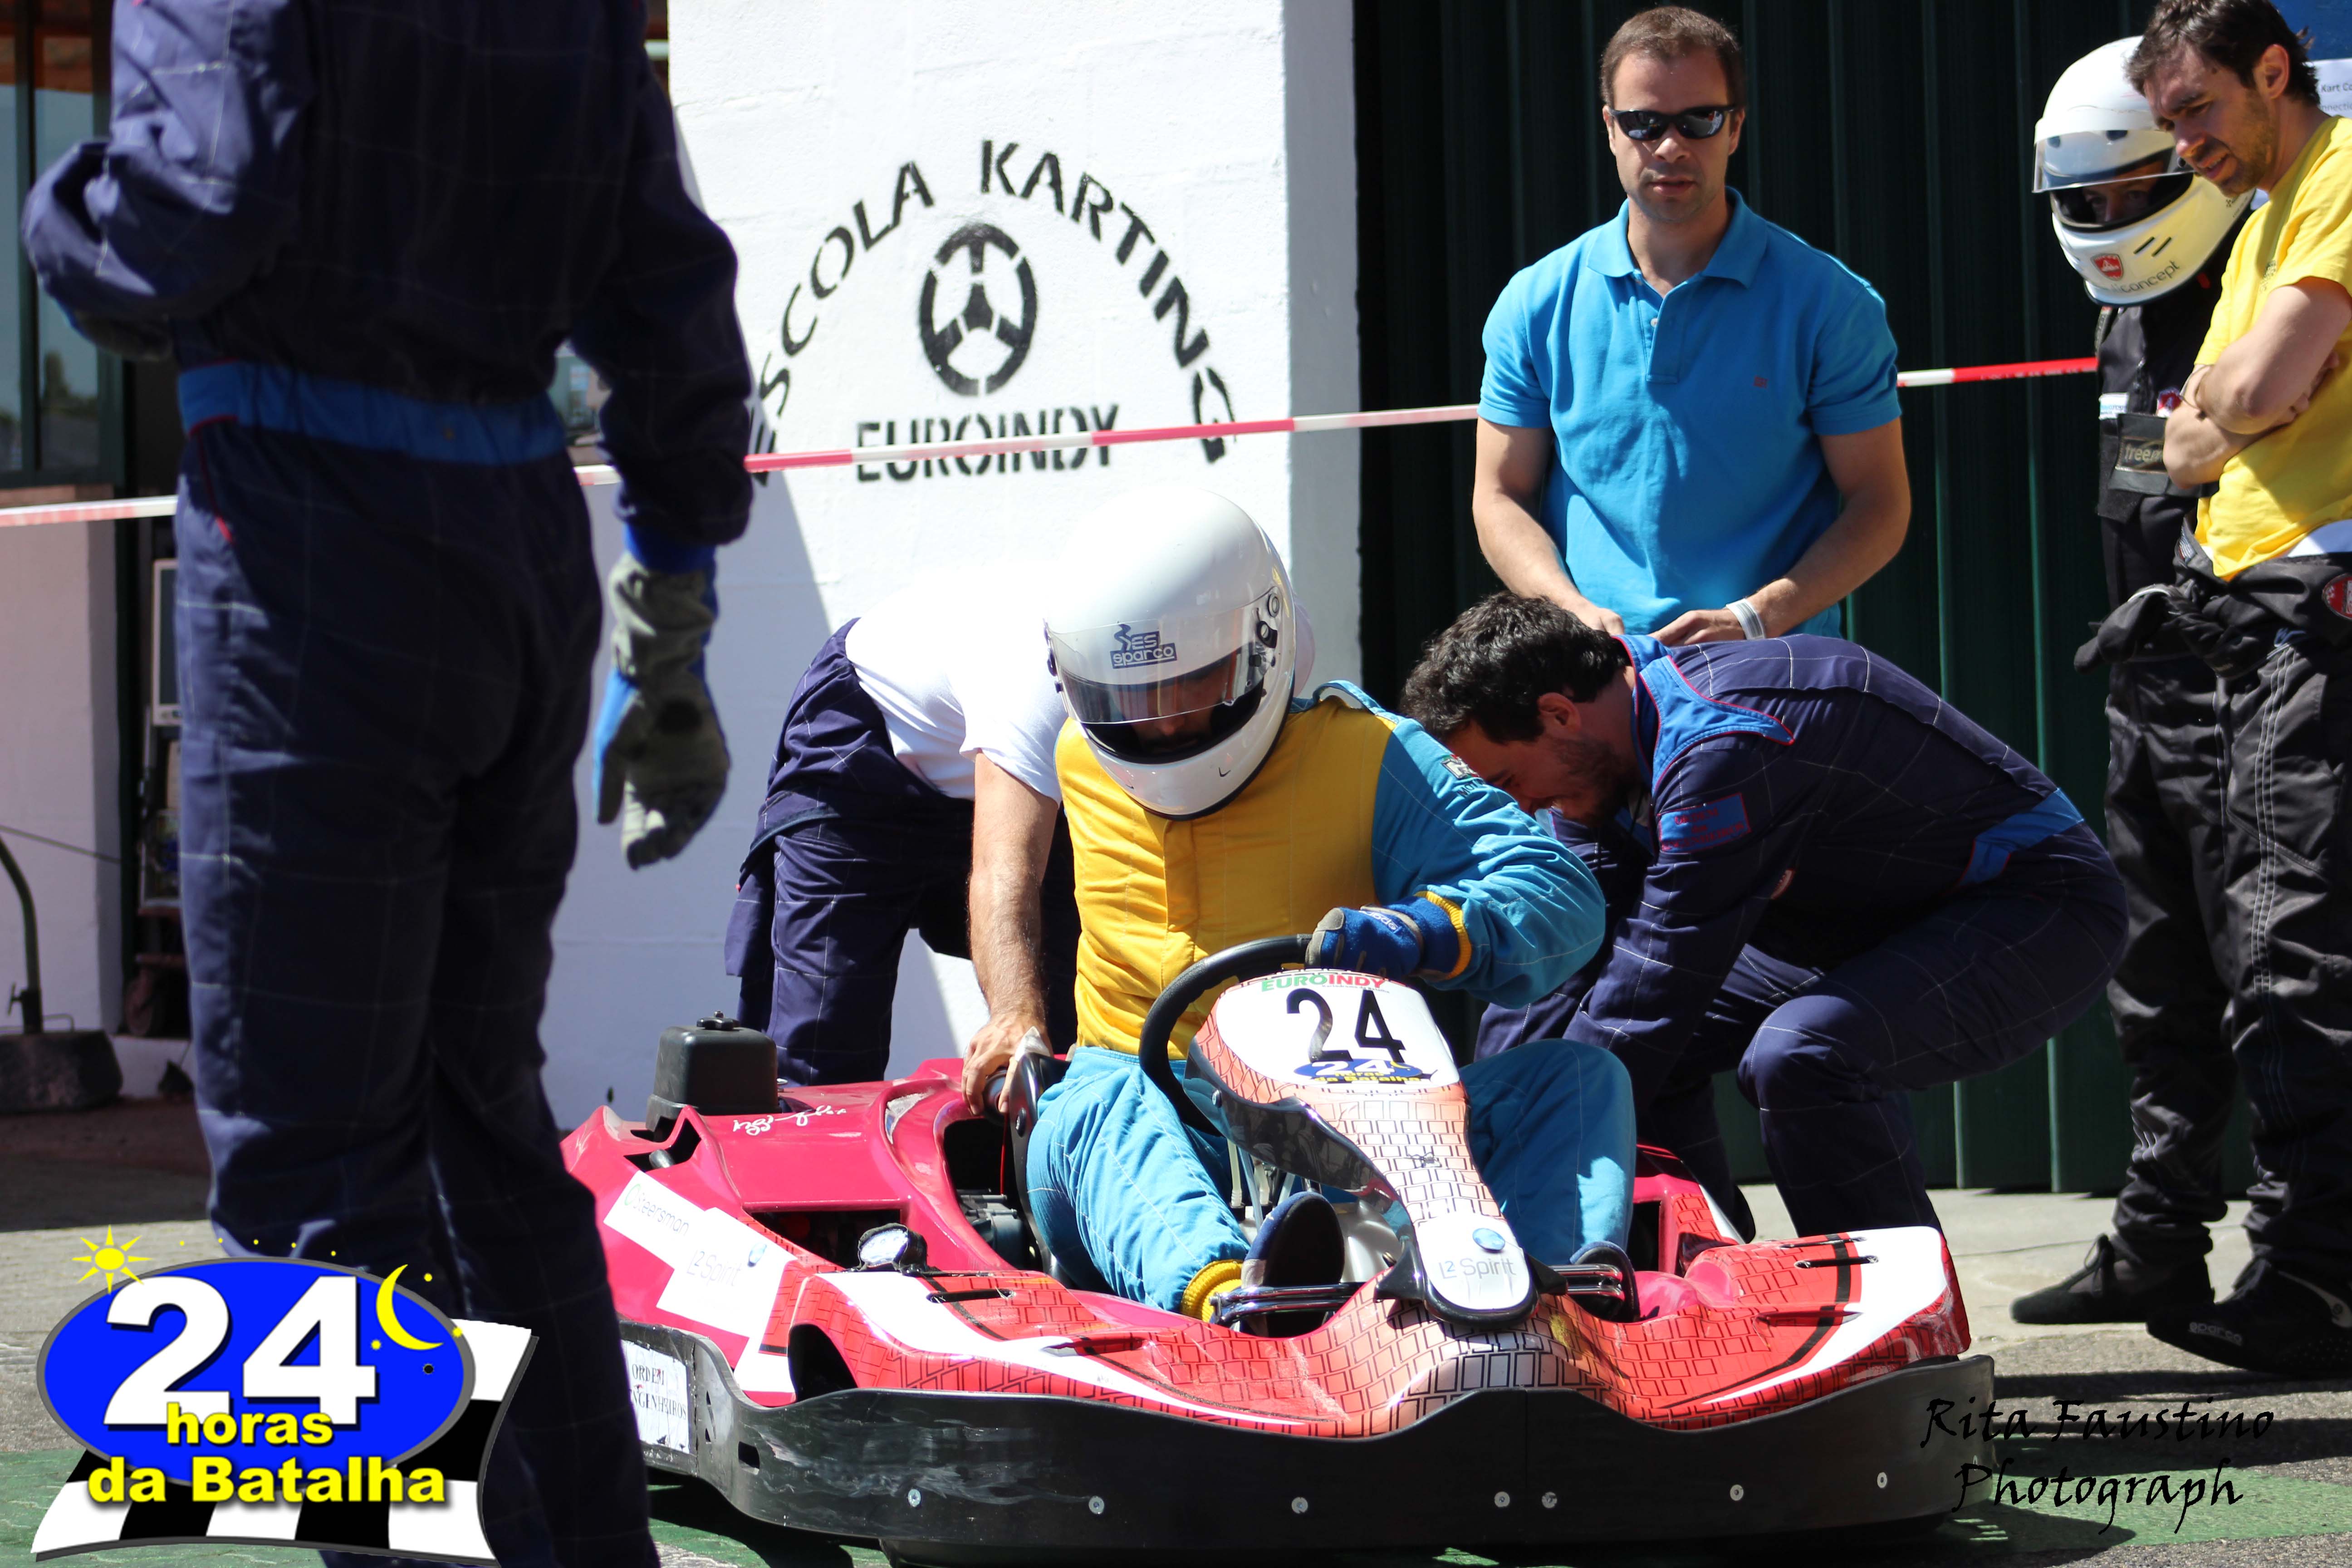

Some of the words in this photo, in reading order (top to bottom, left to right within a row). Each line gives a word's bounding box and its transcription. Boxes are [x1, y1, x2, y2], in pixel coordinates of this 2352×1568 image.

[980, 139, 1236, 463] KARTING
[857, 404, 1119, 483] EUROINDY
[1113, 646, 1174, 666] sparco
[1261, 974, 1385, 992] EUROINDY
[1286, 988, 1406, 1063] 24
[1311, 1059, 1396, 1076] 24
[1459, 1258, 1519, 1279] Spirit
[632, 1363, 665, 1386] ORDEM
[631, 1389, 687, 1421] NGENHEIROS
